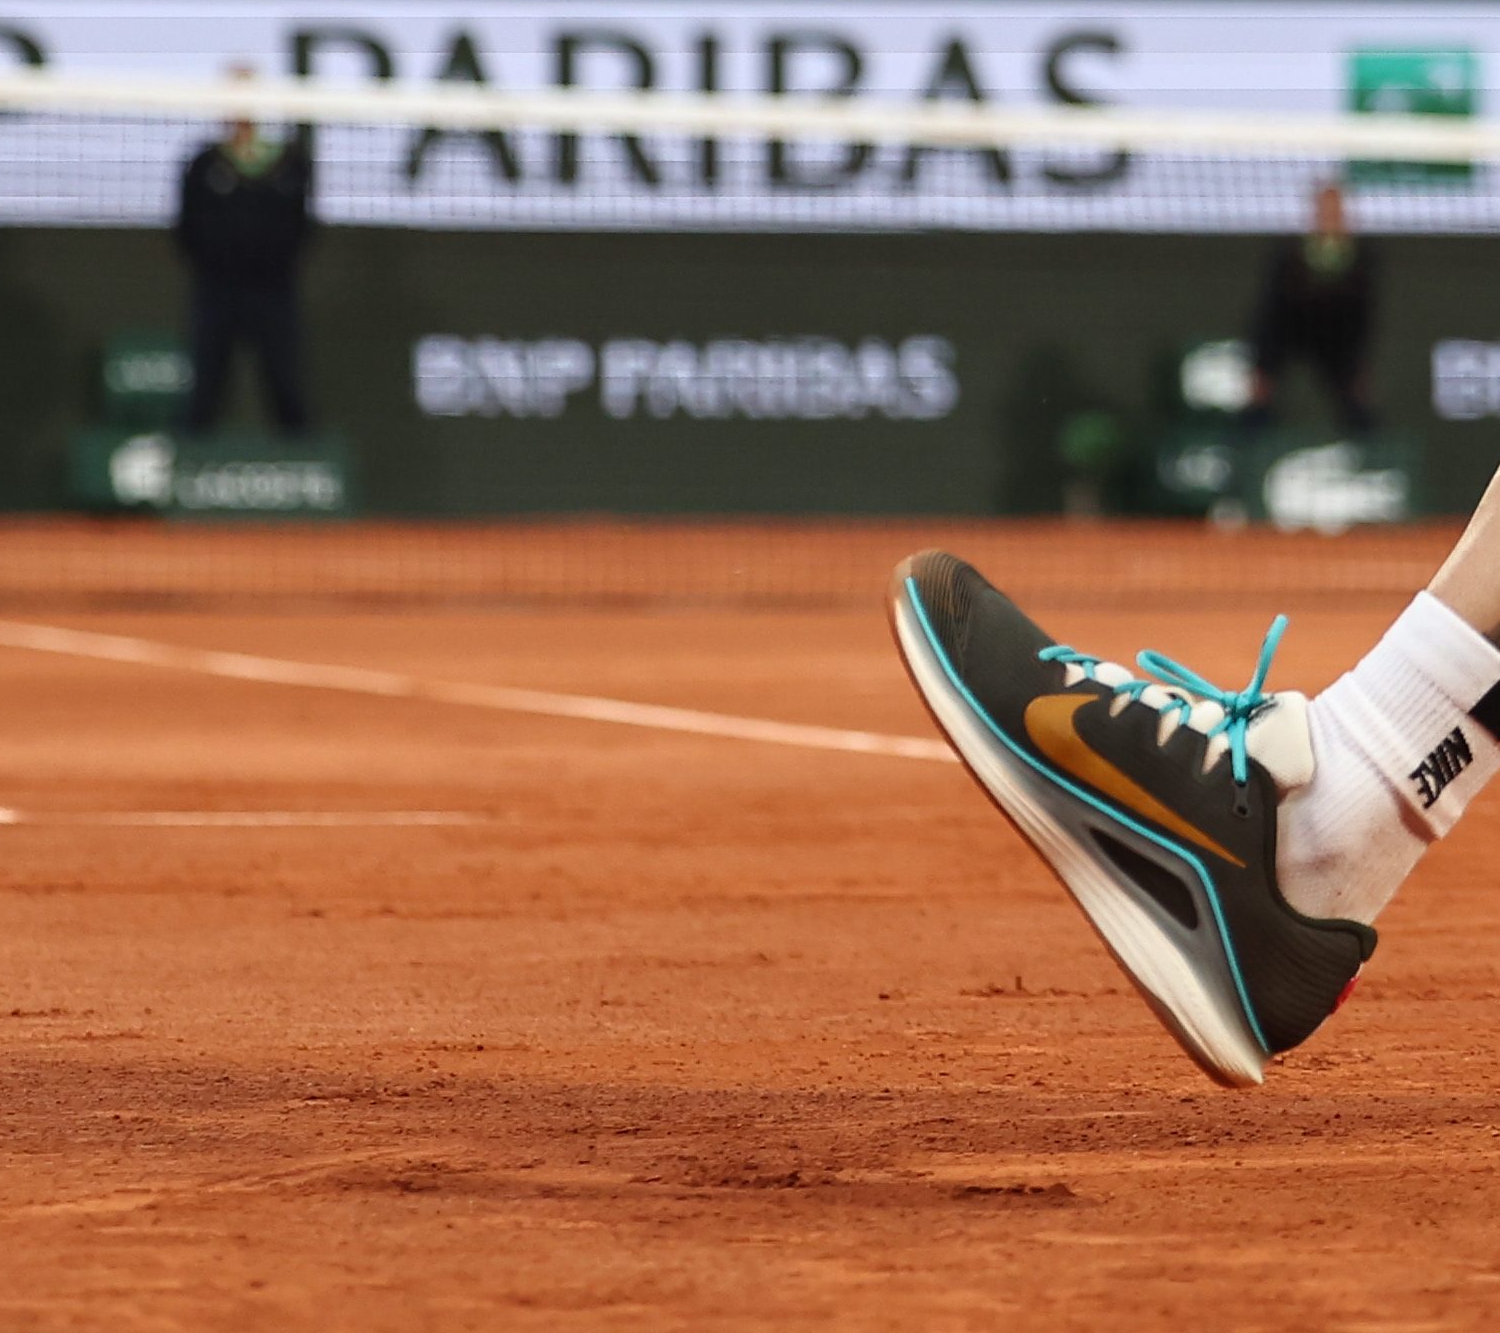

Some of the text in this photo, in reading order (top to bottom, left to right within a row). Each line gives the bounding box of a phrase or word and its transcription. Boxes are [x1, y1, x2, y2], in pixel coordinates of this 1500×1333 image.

[290, 23, 1132, 193] PARIBAS
[412, 335, 960, 421] BNP PARIBAS
[1408, 725, 1473, 810] NIKE
